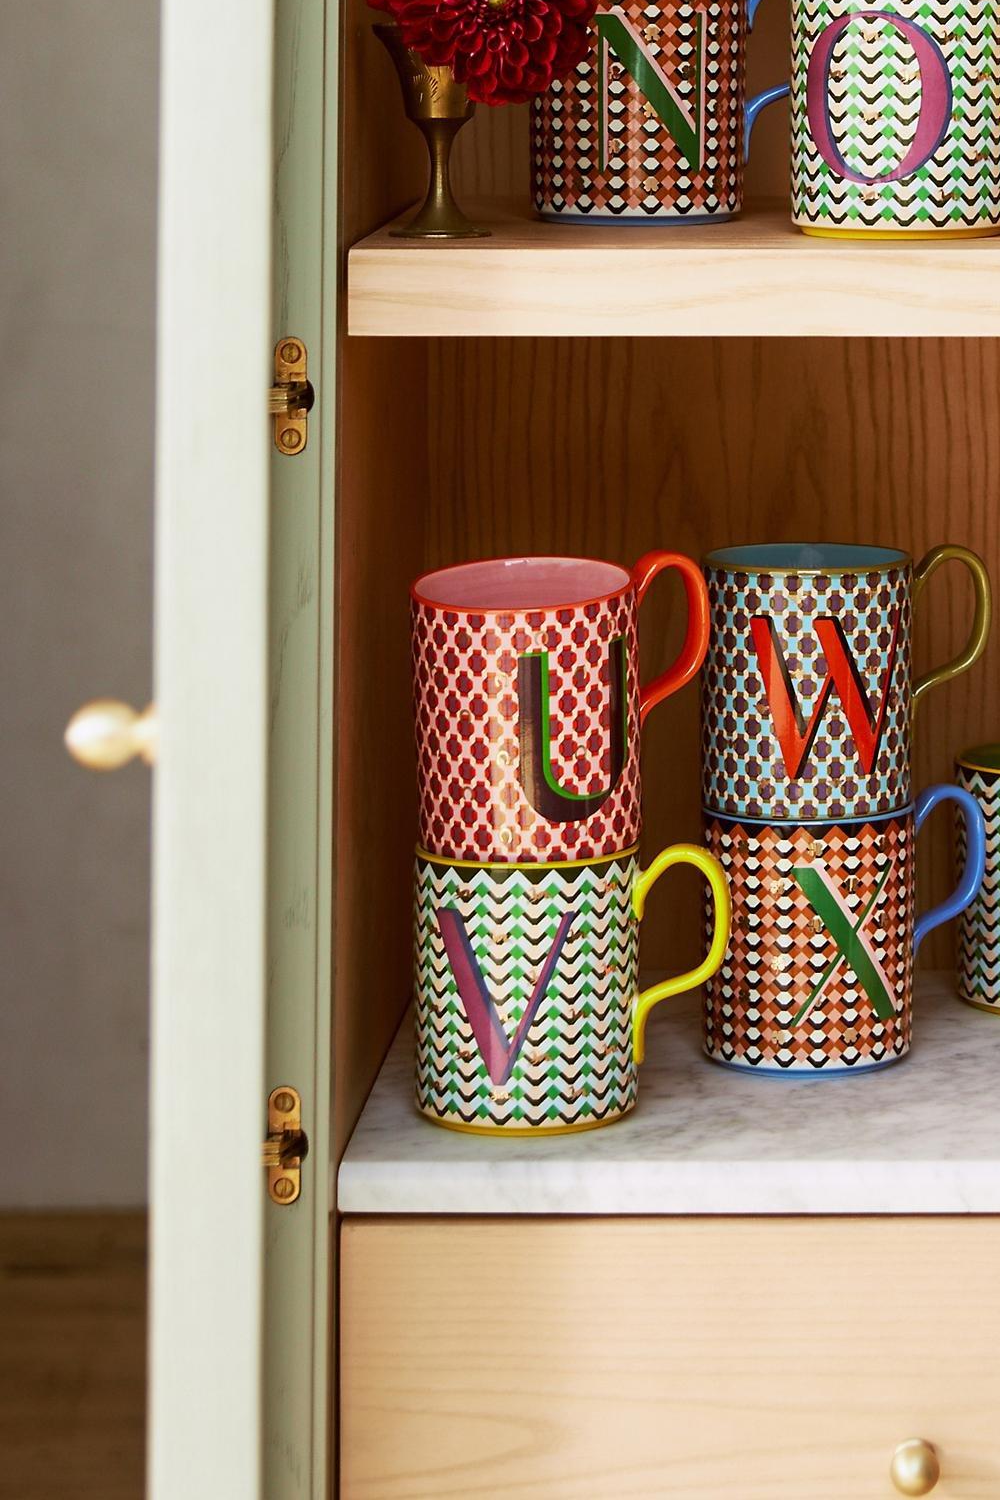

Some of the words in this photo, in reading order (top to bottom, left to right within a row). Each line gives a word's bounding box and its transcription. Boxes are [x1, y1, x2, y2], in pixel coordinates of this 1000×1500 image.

[595, 10, 707, 172] N
[806, 10, 953, 185] O
[517, 636, 628, 823] U
[750, 611, 899, 780] W
[437, 907, 575, 1085] V
[792, 860, 895, 1027] X
